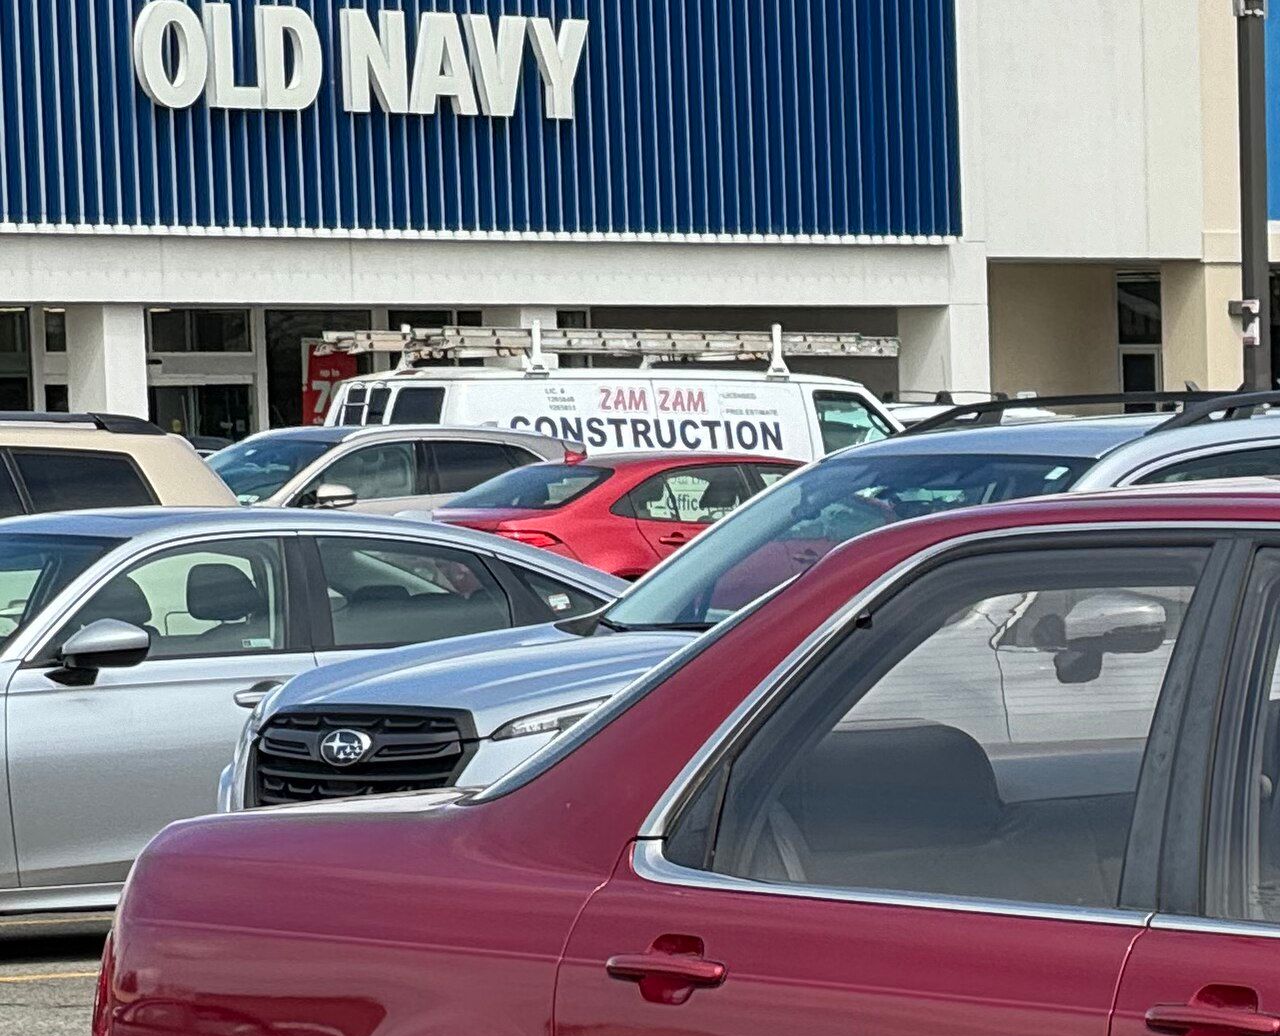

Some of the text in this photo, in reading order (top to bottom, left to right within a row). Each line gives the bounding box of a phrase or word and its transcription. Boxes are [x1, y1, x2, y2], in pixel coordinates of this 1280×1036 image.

[134, 0, 589, 119] OLD NAVY
[599, 387, 707, 413] ZAM ZAM
[666, 493, 705, 512] Offic
